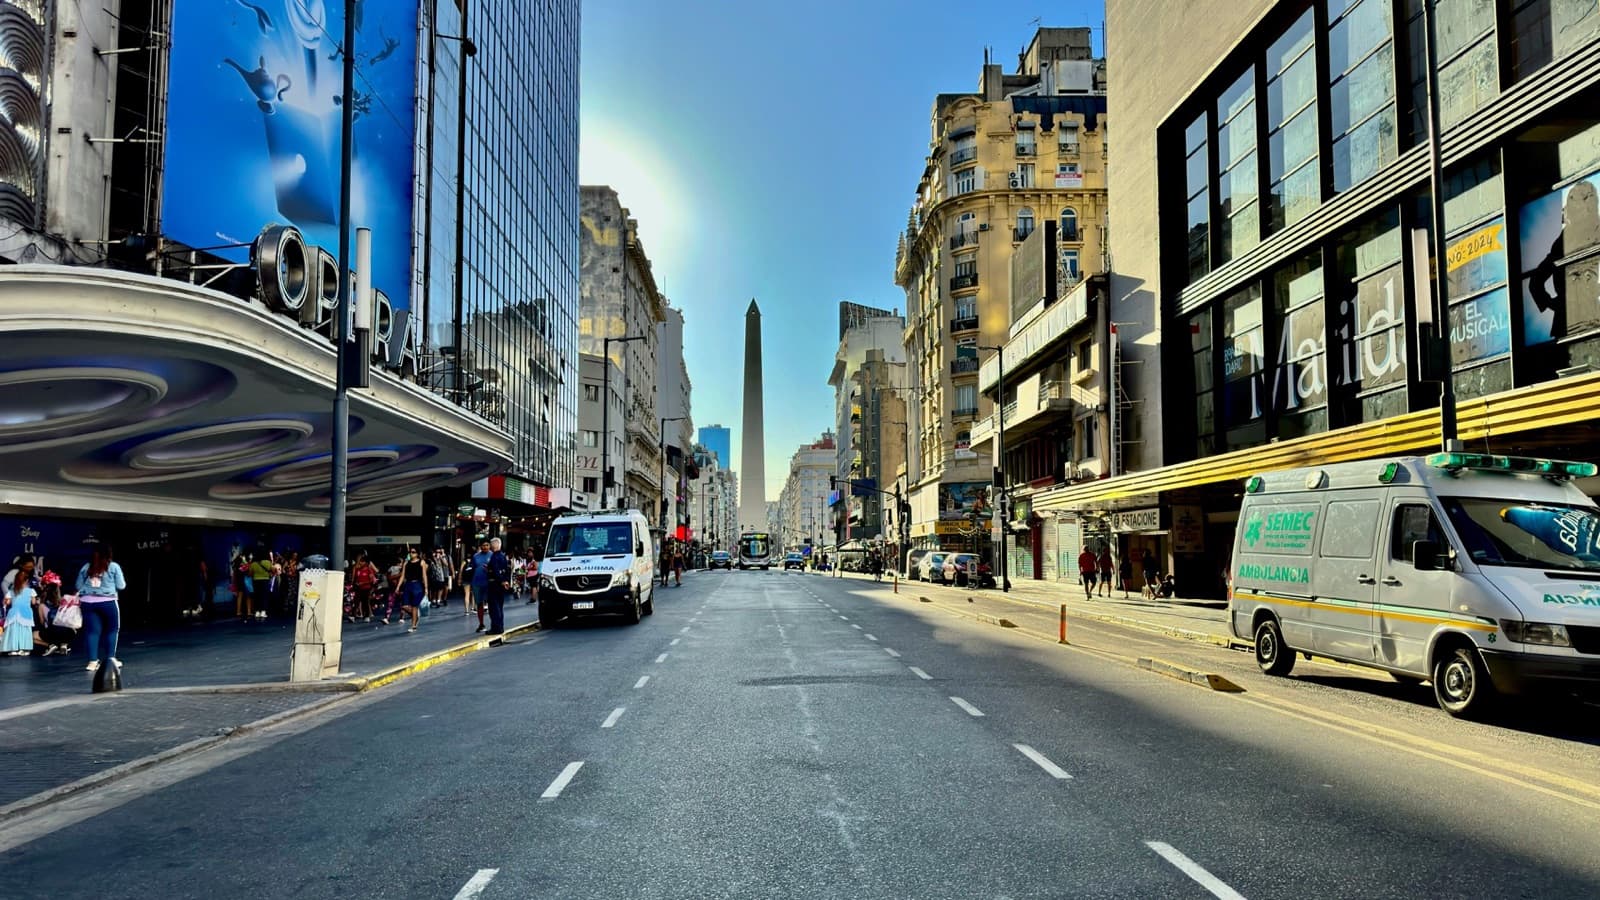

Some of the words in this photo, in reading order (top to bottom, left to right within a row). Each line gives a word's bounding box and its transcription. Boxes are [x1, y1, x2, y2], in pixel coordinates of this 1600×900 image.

[1467, 234, 1493, 260] 2024
[1465, 301, 1482, 321] EL
[1250, 276, 1406, 419] Maild
[1122, 511, 1157, 528] ESTACIONE
[1265, 511, 1315, 531] SEMEC
[1238, 564, 1309, 583] AMBULANCIA
